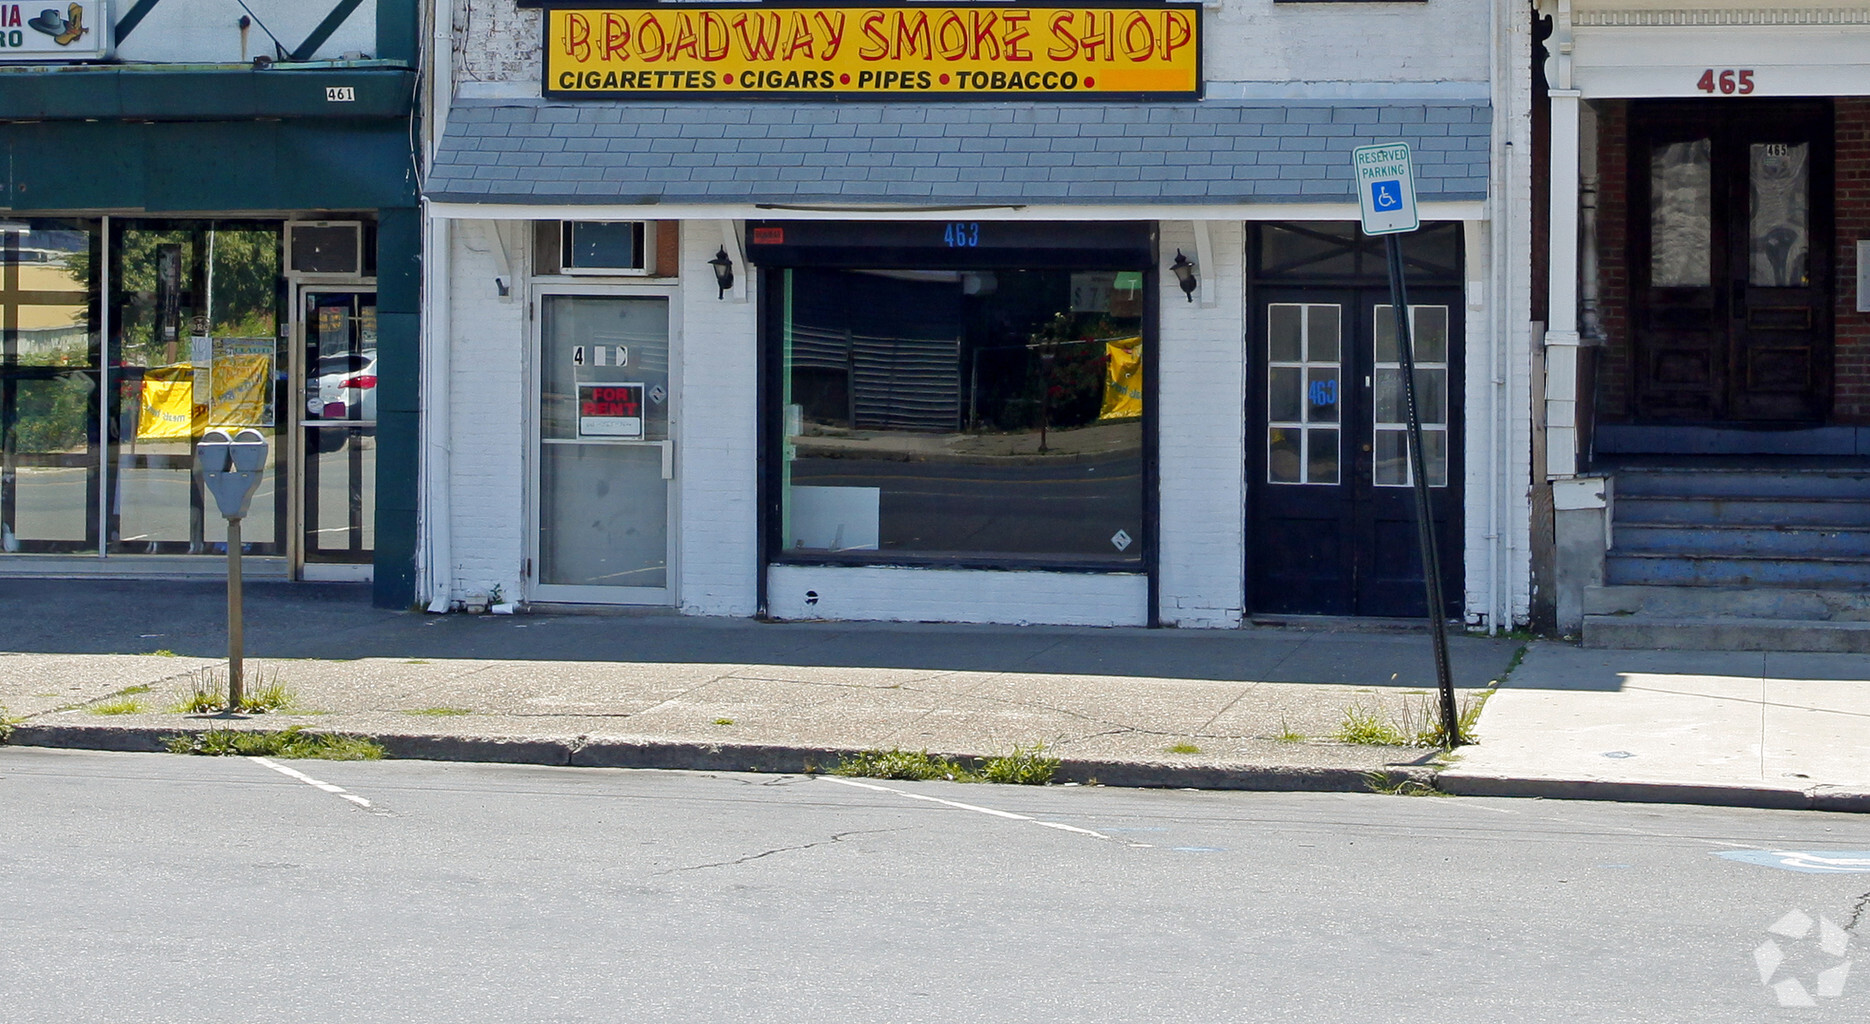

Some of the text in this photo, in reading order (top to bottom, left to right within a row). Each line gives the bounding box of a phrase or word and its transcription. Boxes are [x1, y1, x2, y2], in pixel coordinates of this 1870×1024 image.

[561, 9, 1191, 63] BROADWAY SMOKE SHOP
[559, 70, 1079, 90] CIGARETTES CIGARS PIPES TOBACCO
[1697, 69, 1754, 94] 465
[328, 88, 352, 100] 461
[1358, 149, 1407, 164] RESERVED
[1768, 144, 1786, 156] 465
[1362, 164, 1405, 179] PARKING
[944, 222, 979, 247] 463
[592, 387, 629, 401] FOR
[1308, 379, 1337, 406] 463
[582, 402, 639, 416] RENT
